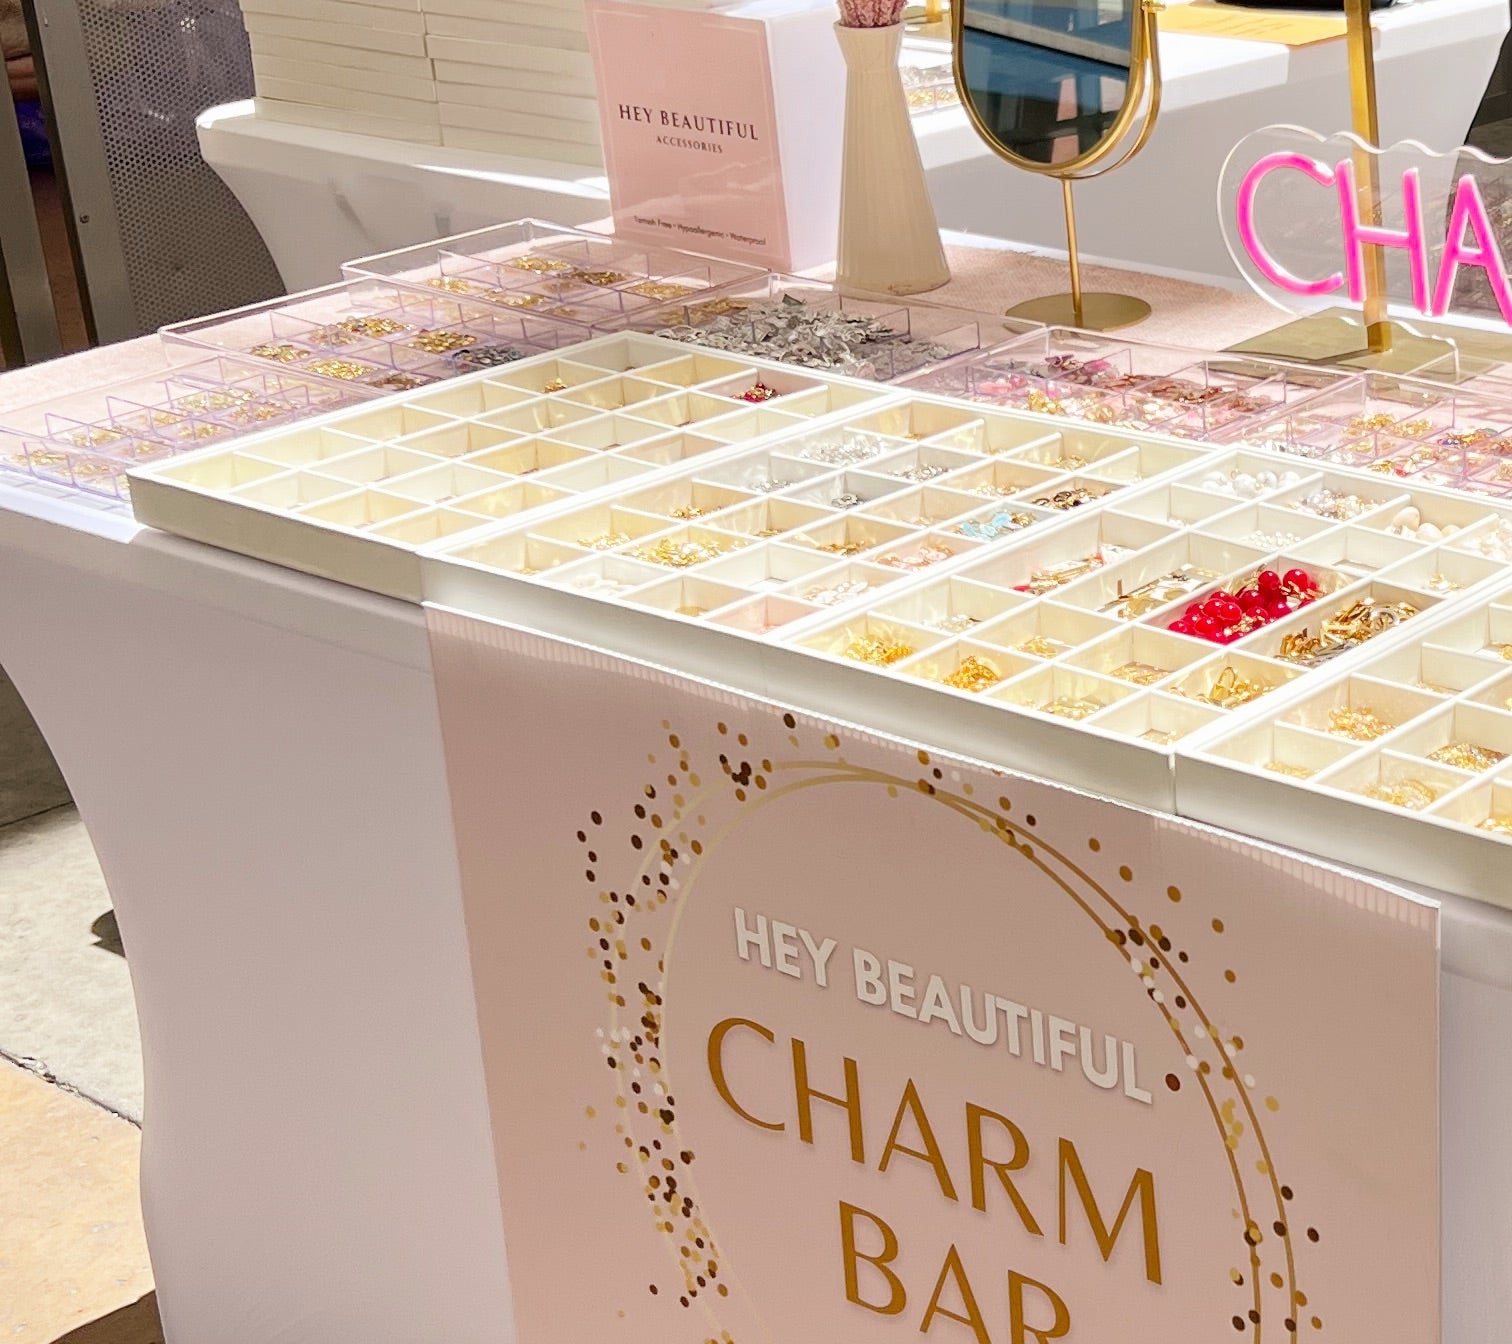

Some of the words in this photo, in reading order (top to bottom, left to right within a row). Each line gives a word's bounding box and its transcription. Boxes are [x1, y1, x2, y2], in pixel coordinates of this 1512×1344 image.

[618, 104, 652, 123] HEY
[660, 110, 759, 141] BEAUTIFUL
[656, 135, 723, 153] ACCESSORIES
[733, 906, 839, 989] HEY
[852, 946, 1154, 1106] BEAUTIFUL
[705, 1016, 1163, 1287] CHARM
